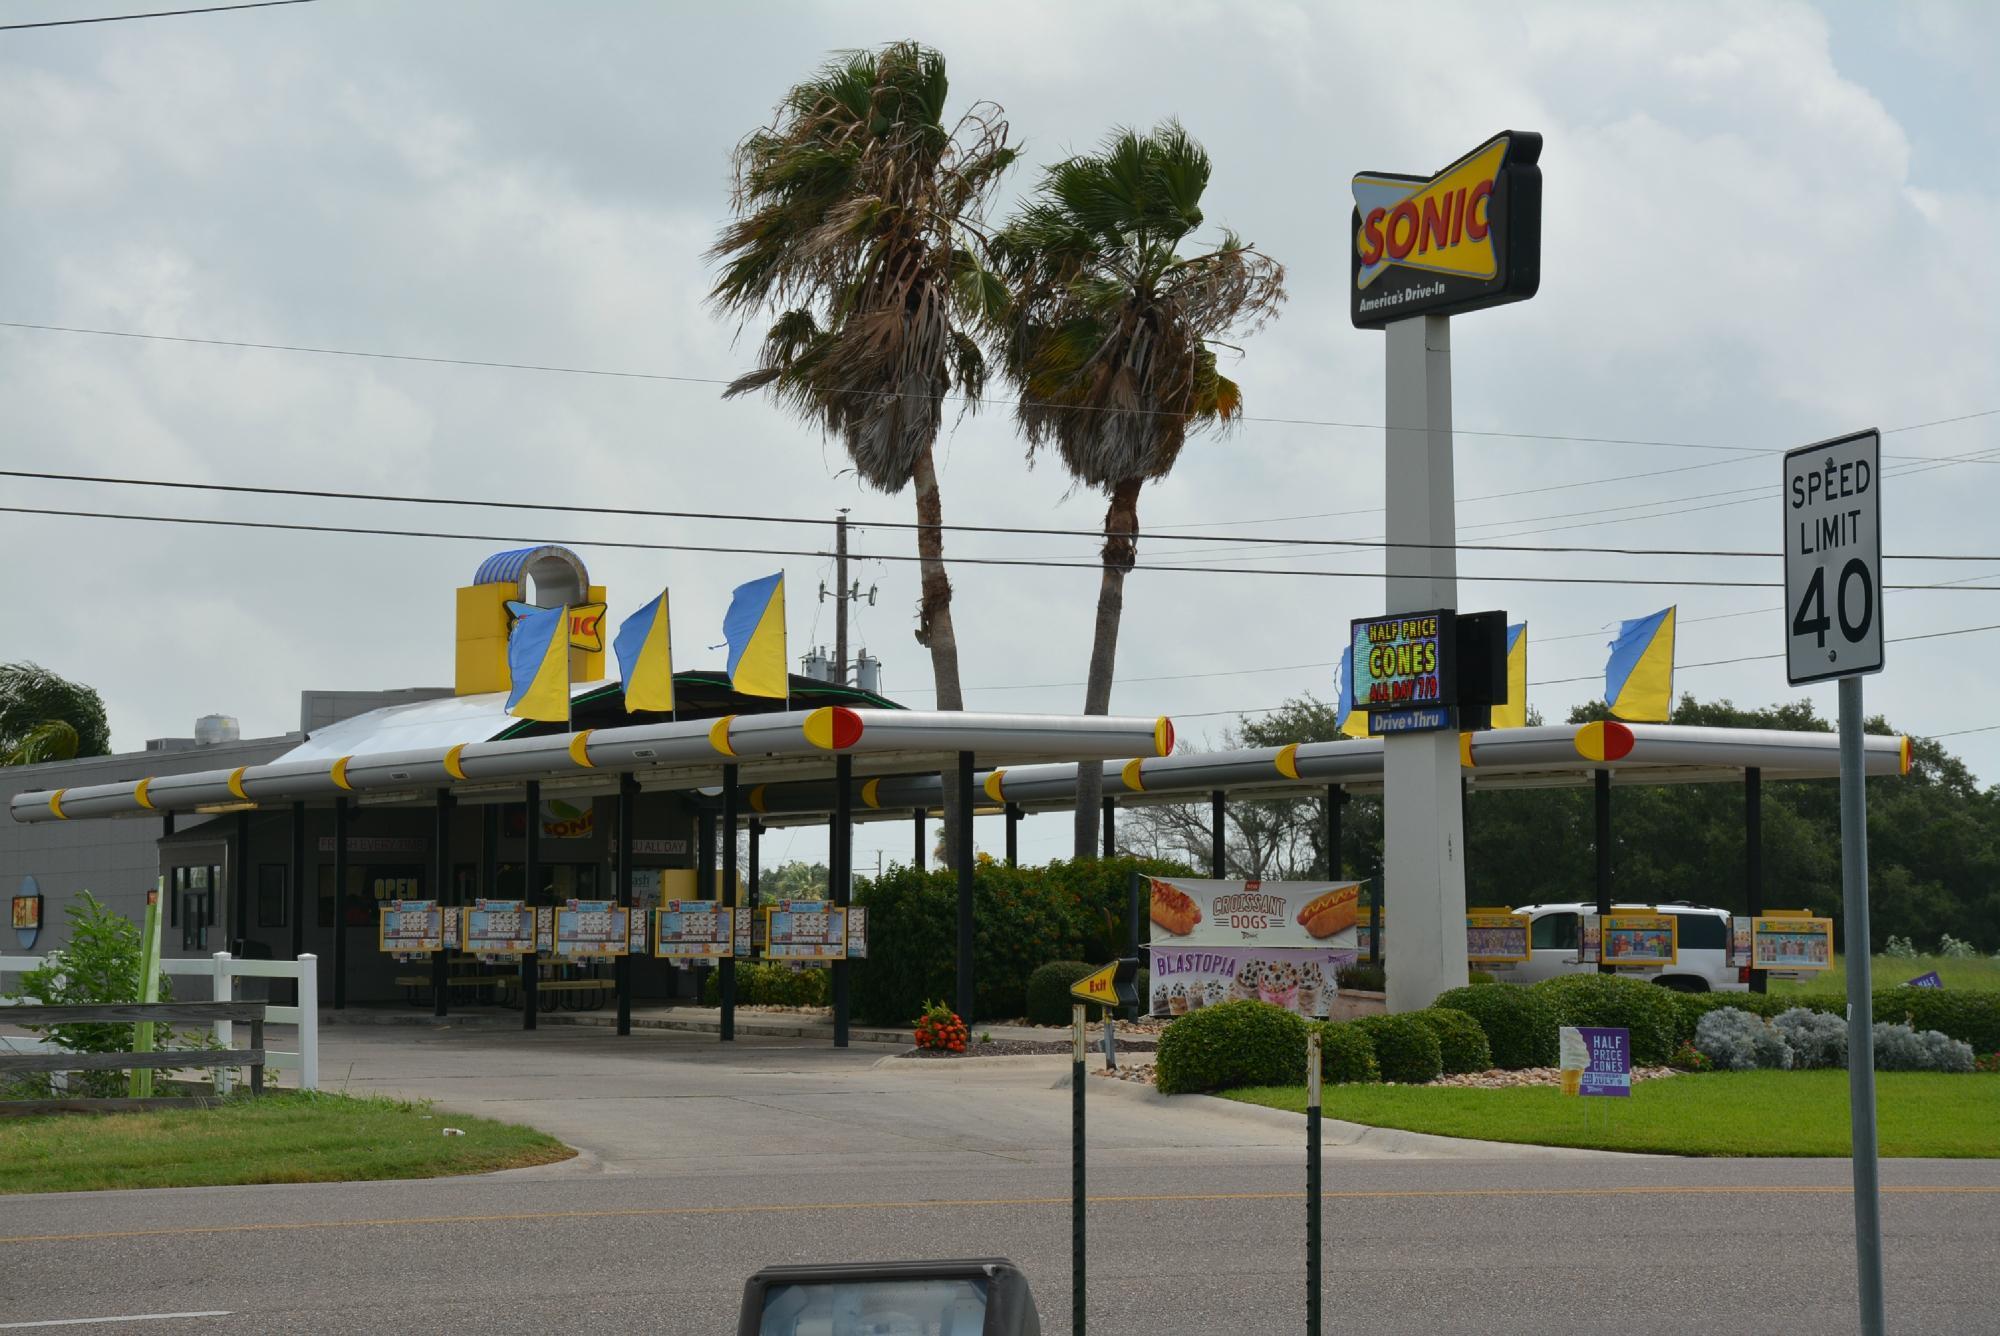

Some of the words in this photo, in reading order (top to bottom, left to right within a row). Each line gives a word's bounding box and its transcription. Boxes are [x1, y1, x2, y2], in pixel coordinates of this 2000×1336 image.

[1361, 180, 1493, 266] SONIC
[1360, 290, 1403, 312] America's
[1792, 459, 1870, 509] SPEED
[1801, 509, 1861, 555] LIMIT
[1793, 558, 1873, 648] 40
[1370, 623, 1397, 642] HALF
[1402, 619, 1436, 639] PRICE
[1370, 642, 1436, 677] CONES
[1370, 683, 1389, 701] ALL
[1394, 680, 1414, 699] DAY
[374, 879, 417, 899] OPEN
[1213, 894, 1286, 917] CROISSANT
[1231, 915, 1267, 929] DOGS
[1593, 1036, 1622, 1049] HALF
[1593, 1049, 1623, 1061] PRICE
[1593, 1061, 1623, 1072] CONES
